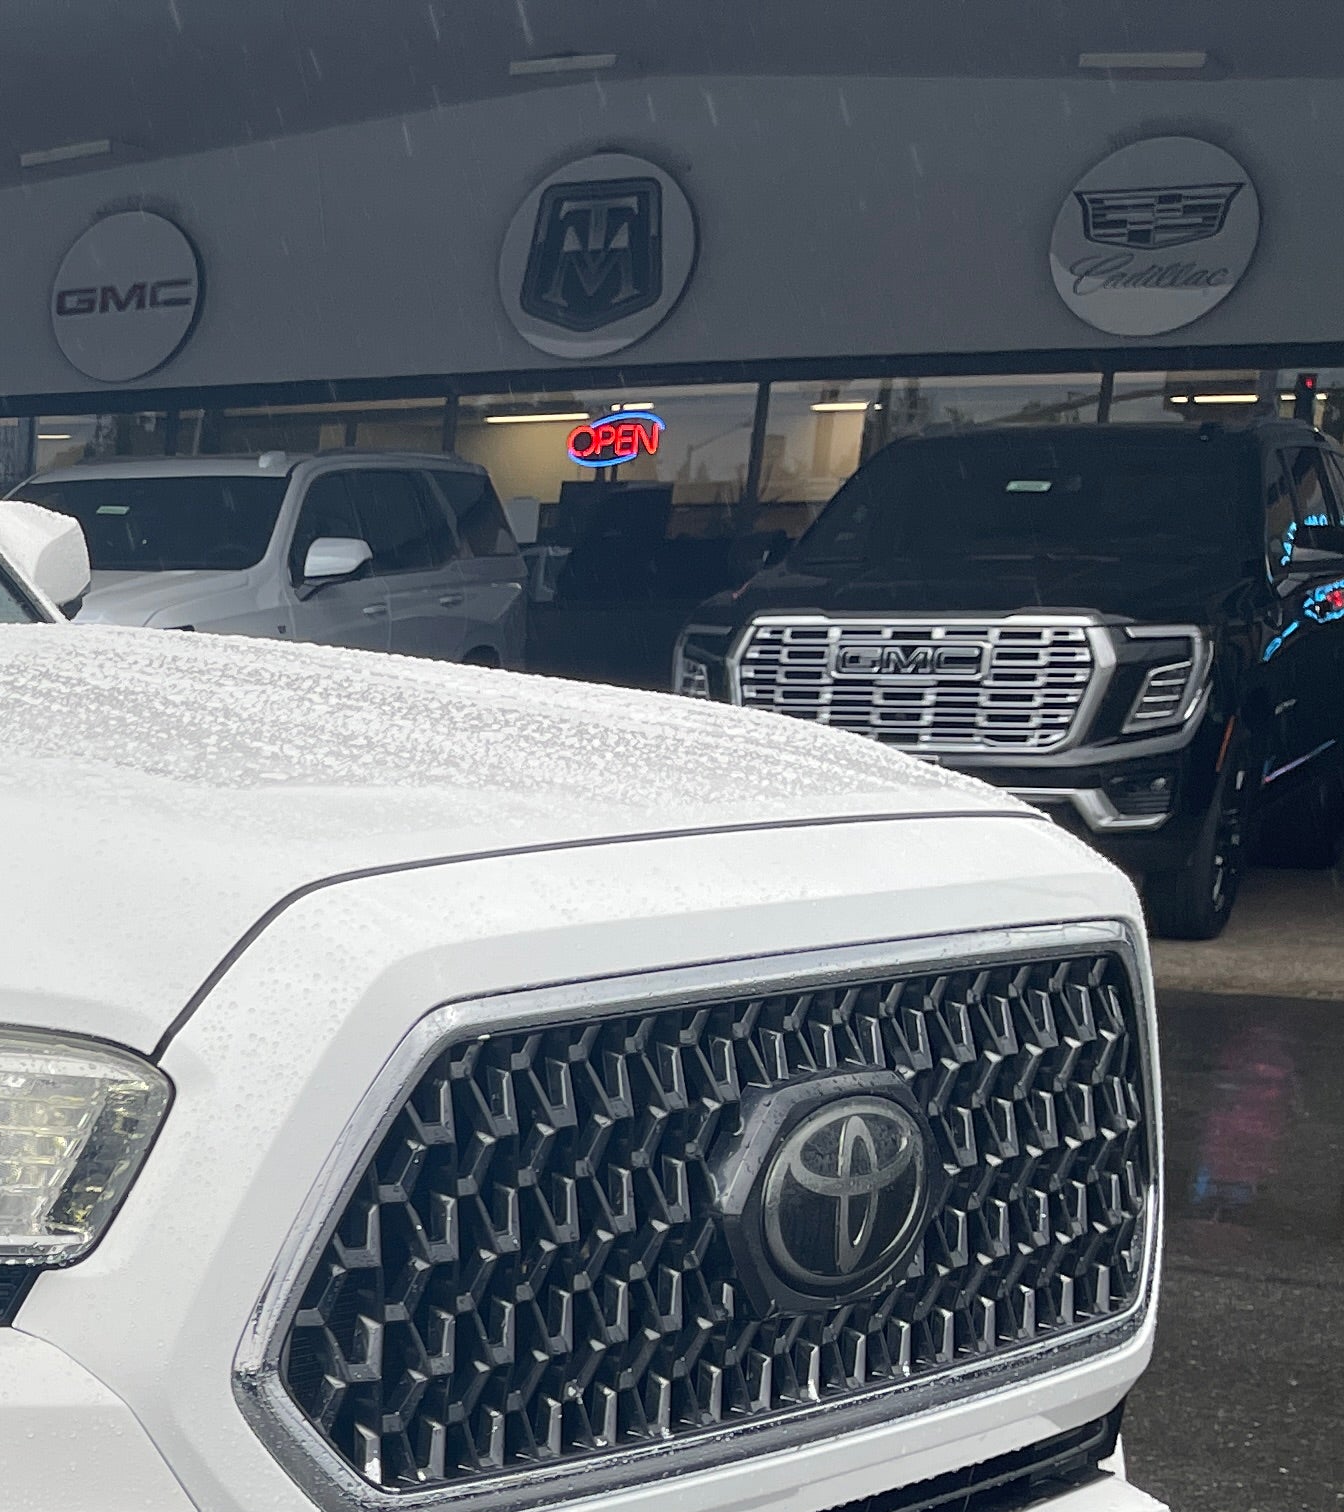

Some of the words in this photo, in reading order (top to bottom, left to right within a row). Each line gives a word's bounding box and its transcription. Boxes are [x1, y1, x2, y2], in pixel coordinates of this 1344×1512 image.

[1070, 253, 1228, 296] Cadillac
[56, 278, 193, 317] GMC
[568, 423, 659, 458] OPEN
[835, 645, 984, 676] GMC
